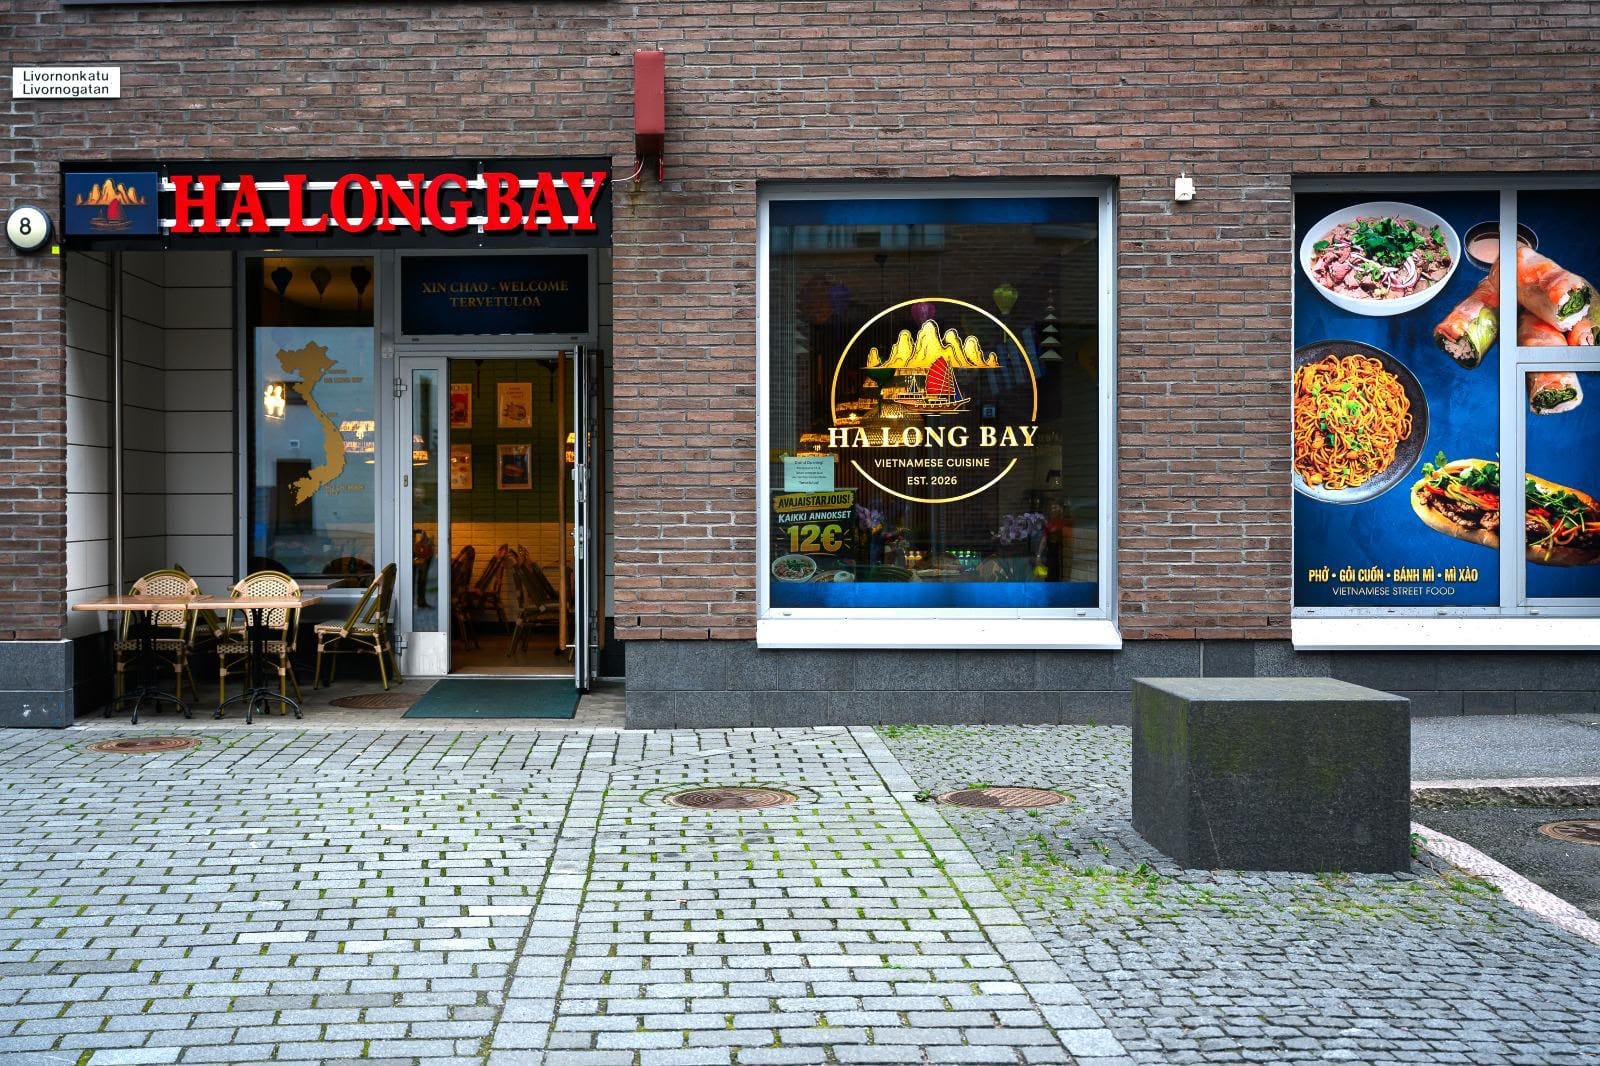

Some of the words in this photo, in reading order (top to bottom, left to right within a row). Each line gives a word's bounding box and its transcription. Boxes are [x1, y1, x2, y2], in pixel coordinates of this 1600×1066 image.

[23, 70, 109, 82] Livornonkatu
[23, 83, 109, 97] Livornogatan
[170, 174, 271, 234] HA
[283, 173, 474, 233] LONG
[482, 171, 607, 231] BAY
[20, 217, 31, 235] 8
[421, 281, 446, 293] XIN
[449, 281, 489, 293] CHAO
[499, 280, 569, 292] WELCOME
[449, 296, 543, 308] TERVETULOA
[828, 426, 871, 448] HA
[880, 426, 969, 448] LONG
[979, 425, 1039, 447] BAY
[874, 458, 944, 468] VIETNAMESE
[946, 458, 990, 468] CUISINE
[907, 476, 929, 486] EST.
[931, 476, 958, 486] 2026
[778, 493, 851, 509] AVAJAISTARJOUS!
[778, 512, 807, 524] KAIKKI
[809, 510, 852, 521] ANNOKSET
[787, 523, 843, 554] 12€
[1308, 565, 1330, 583] PHỞ
[1358, 565, 1384, 582] CUỐN
[1393, 566, 1420, 582] BÁNH
[1422, 566, 1435, 582] MÌ
[1444, 566, 1457, 582] MÌ
[1458, 566, 1479, 582] XÀO
[1332, 586, 1390, 596] VIETNAMESE
[1392, 586, 1423, 596] STREET
[1425, 586, 1455, 596] FOOD
